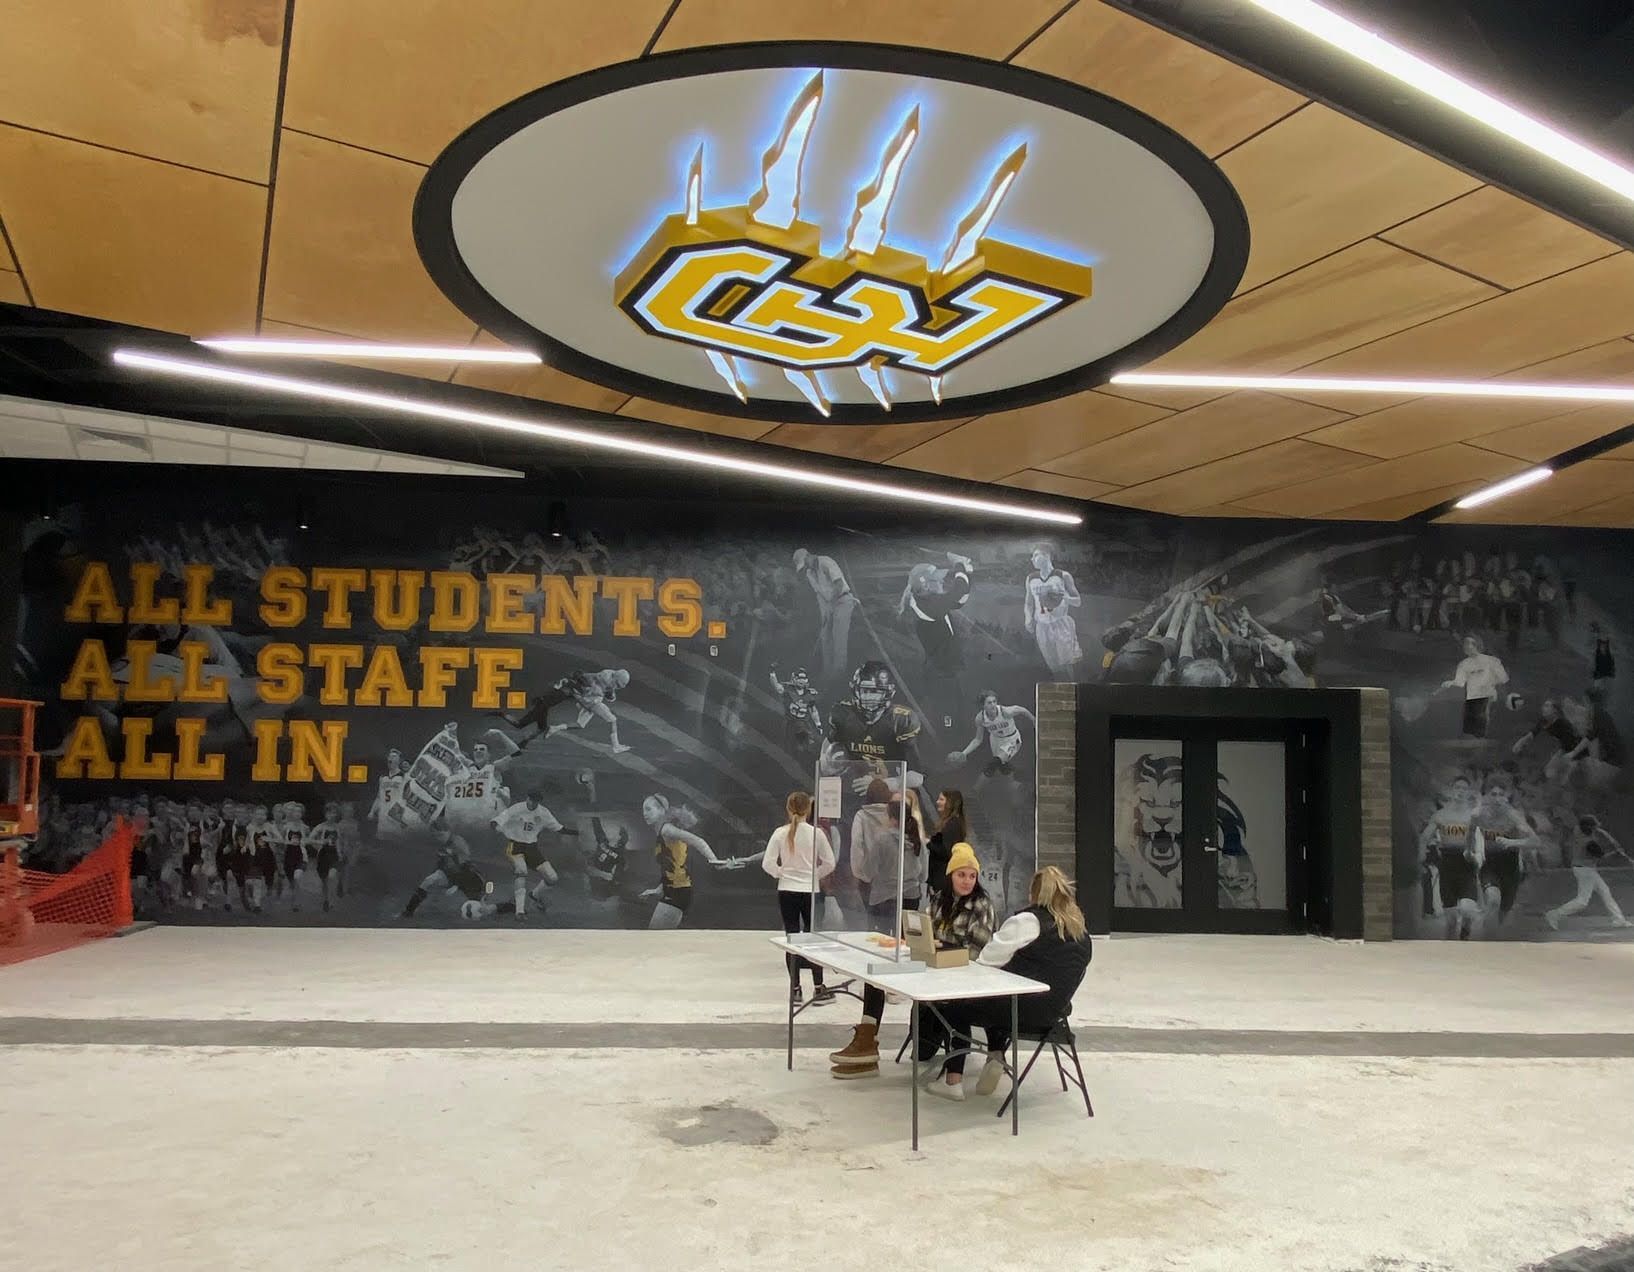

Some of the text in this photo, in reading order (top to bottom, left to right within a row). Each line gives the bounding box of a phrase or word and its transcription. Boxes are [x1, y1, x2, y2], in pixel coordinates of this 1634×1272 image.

[64, 562, 726, 638] ALL STUDENTS.
[60, 639, 526, 709] ALL STAFF.
[56, 716, 224, 780] ALL
[252, 720, 368, 783] IN.
[850, 741, 886, 754] LIONS
[384, 789, 391, 802] 5
